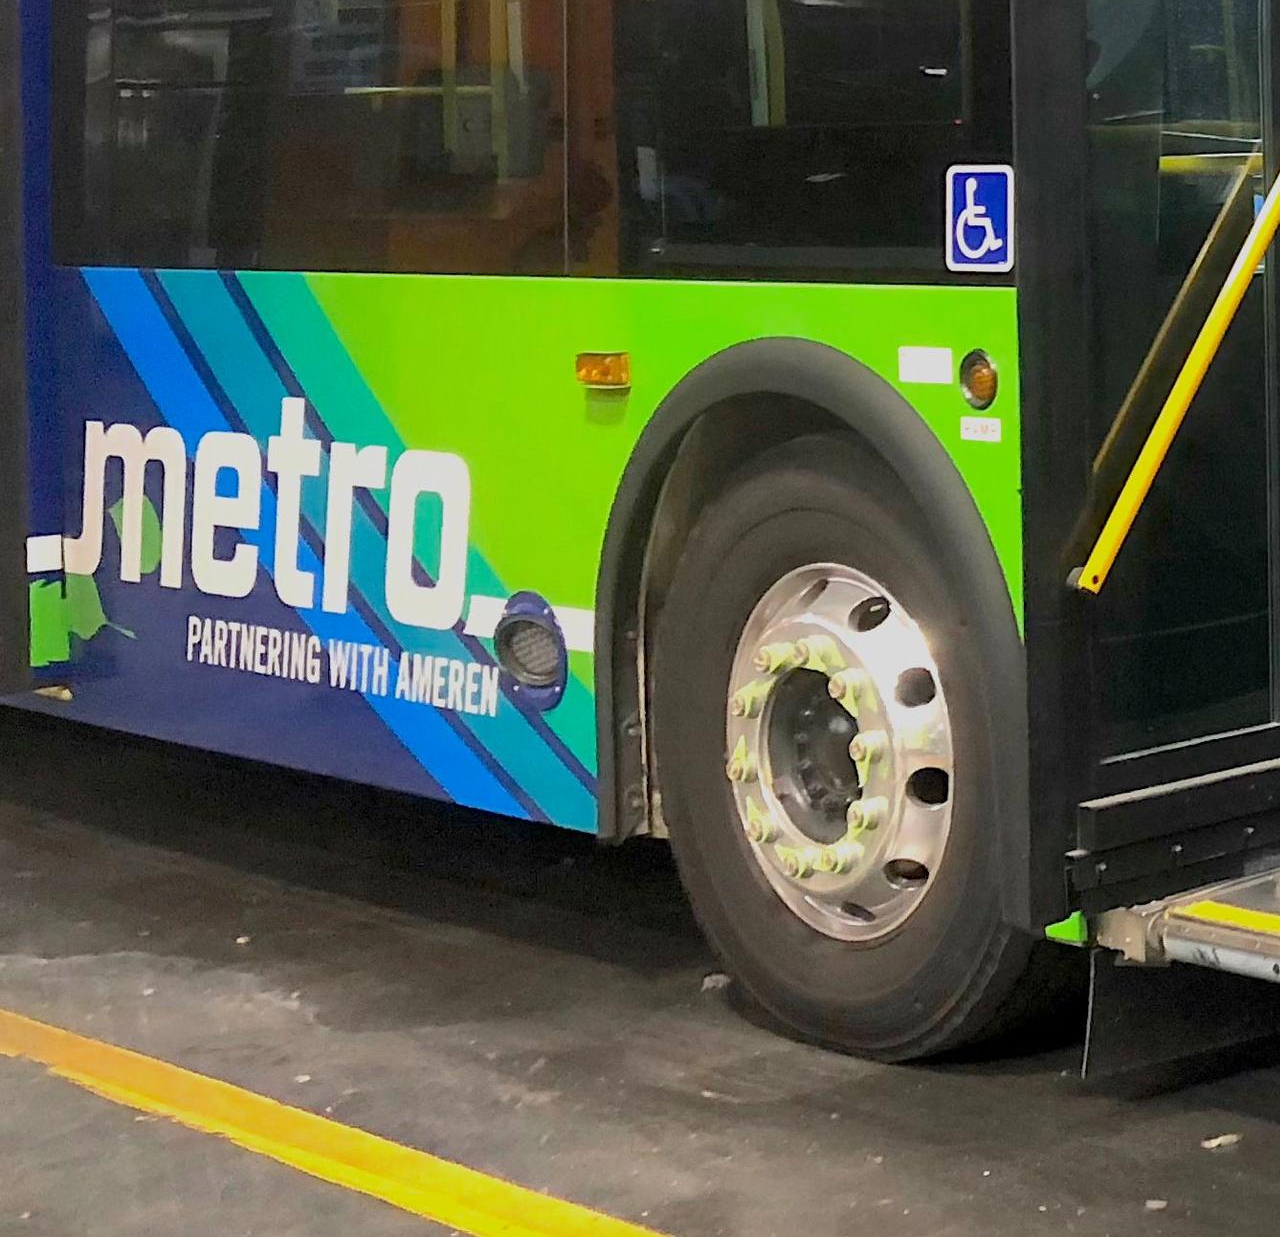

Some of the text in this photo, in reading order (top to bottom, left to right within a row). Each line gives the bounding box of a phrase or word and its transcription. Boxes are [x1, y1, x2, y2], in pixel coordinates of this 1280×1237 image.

[63, 397, 470, 630] metro
[187, 615, 499, 717] PARTNERING WITH AMEREN
